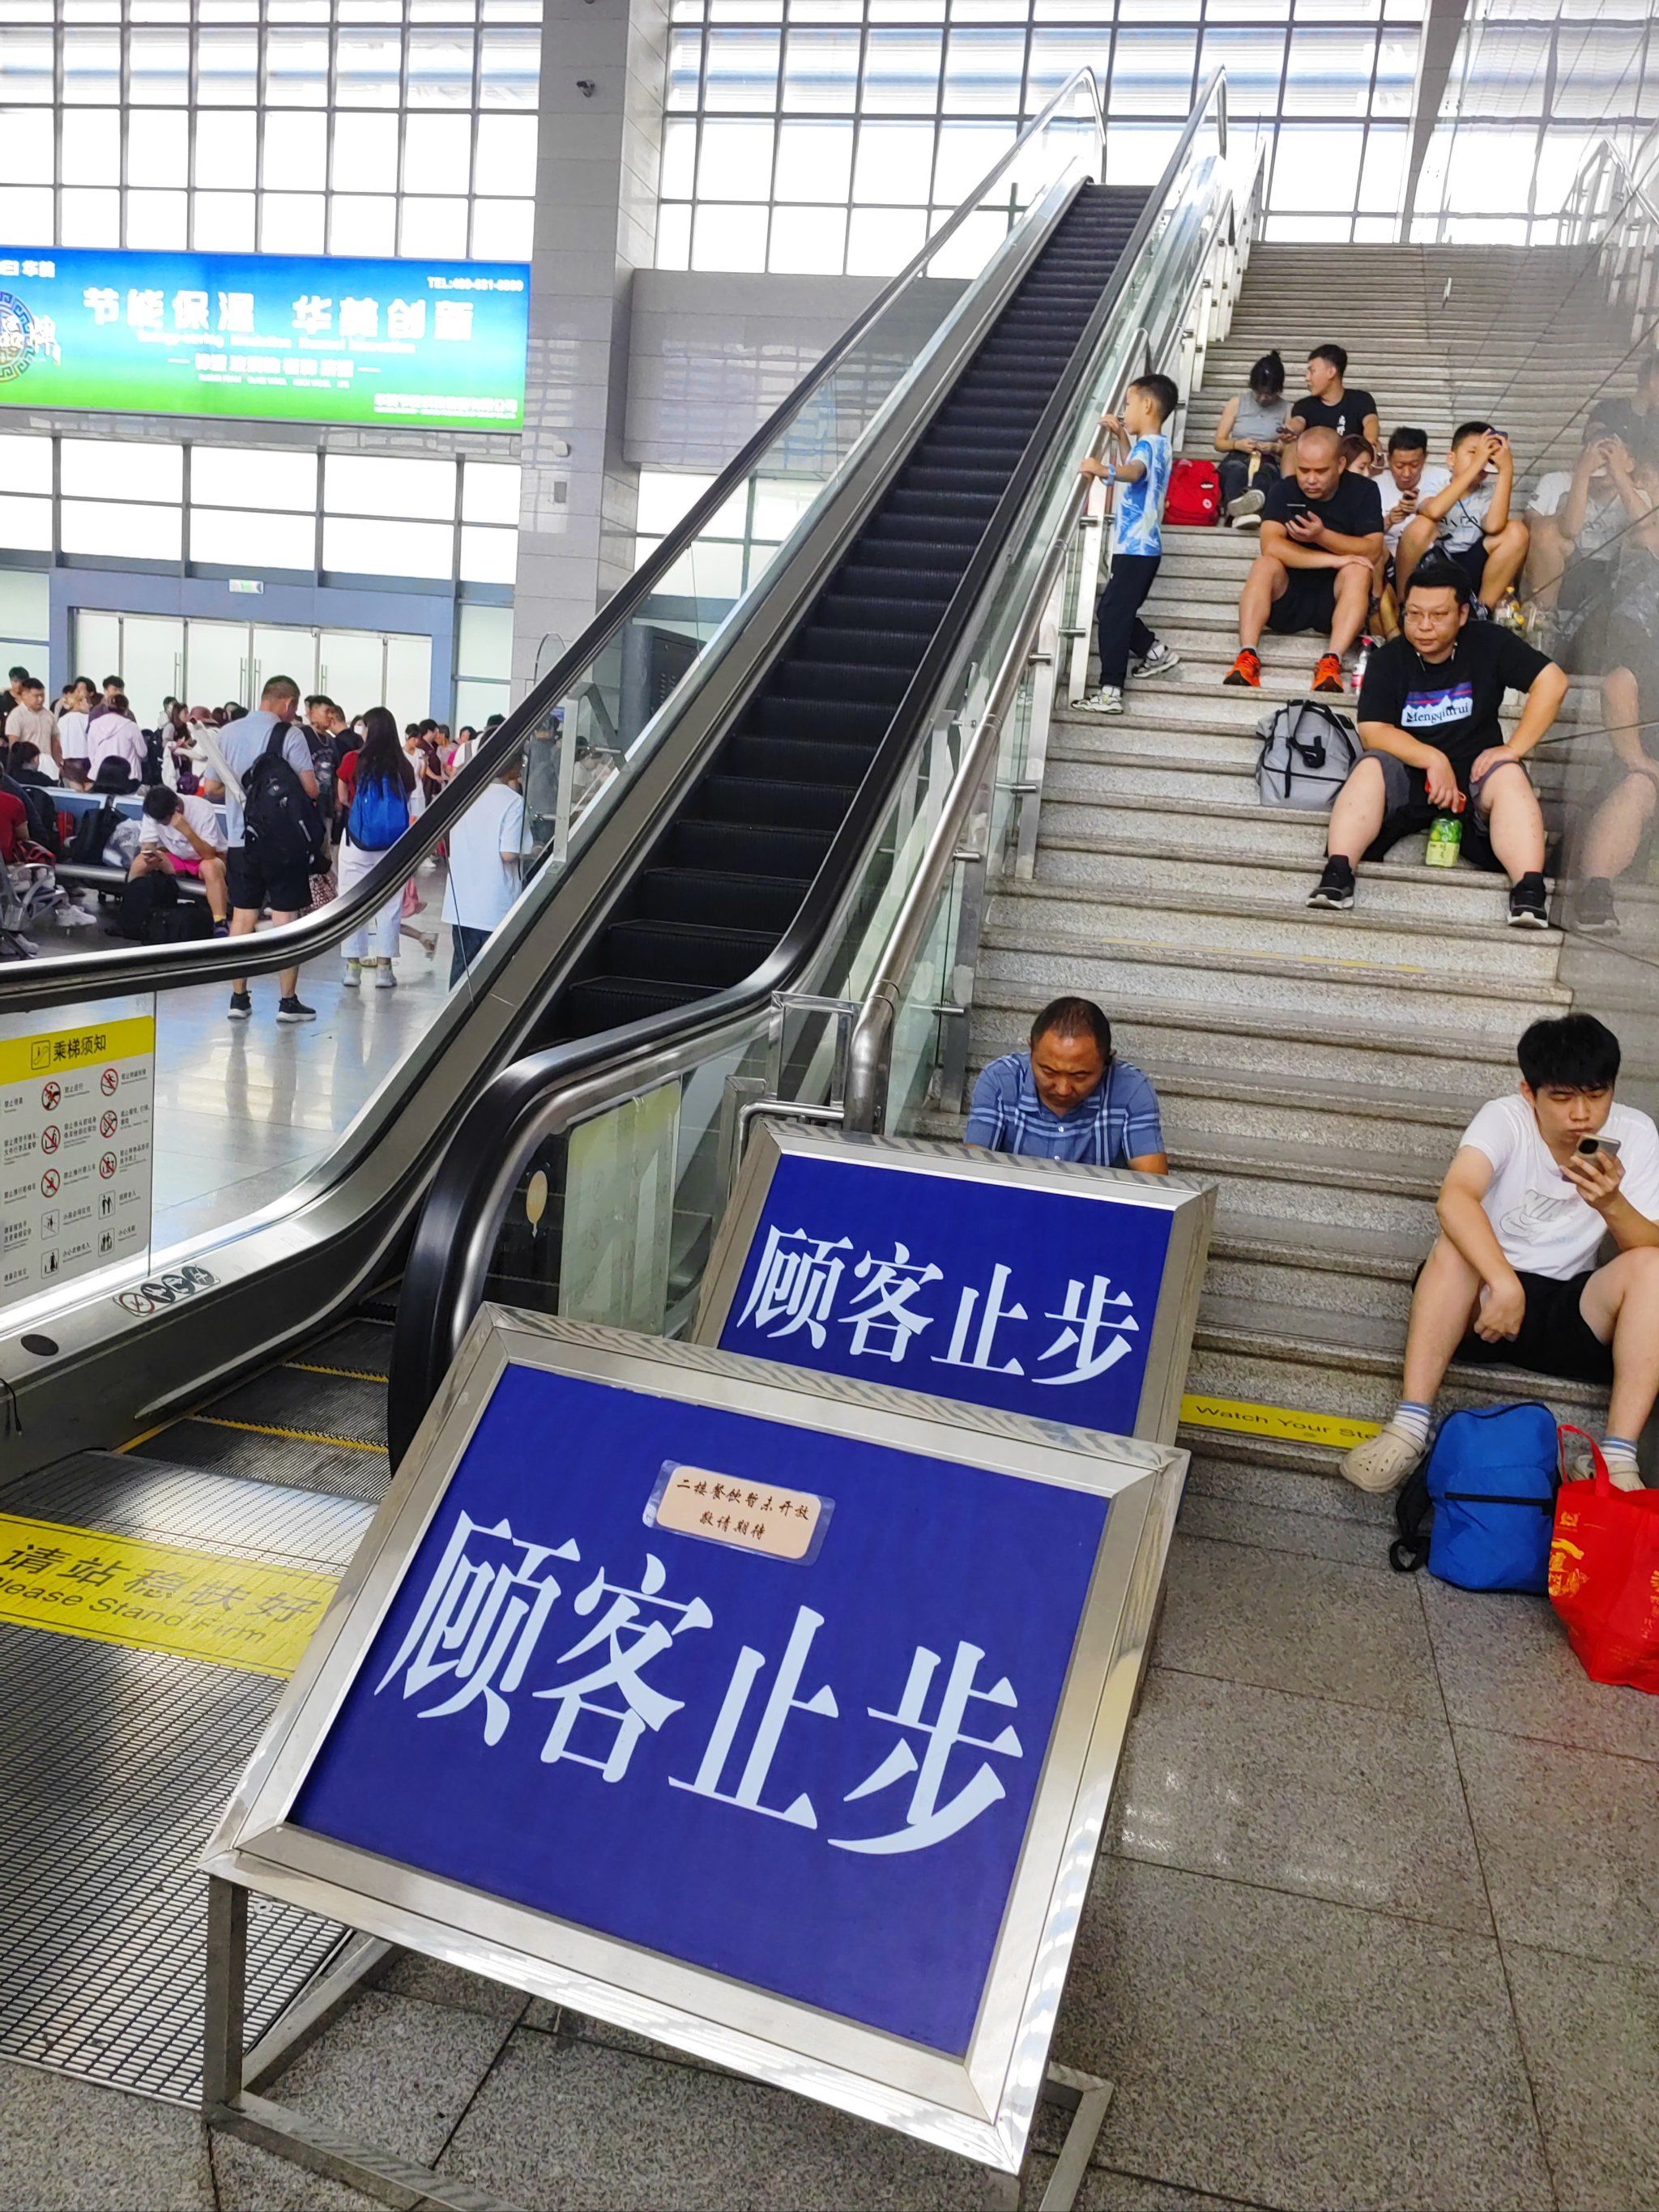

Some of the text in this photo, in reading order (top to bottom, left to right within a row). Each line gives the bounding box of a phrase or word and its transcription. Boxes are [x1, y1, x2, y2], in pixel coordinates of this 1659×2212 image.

[53, 1034, 107, 1062] 乘梯须知
[736, 1224, 1140, 1385] 顾客止步
[1196, 1405, 1378, 1439] Watch Your Ste
[676, 1479, 809, 1520] 二楼餐饮暂未开放
[699, 1511, 766, 1541] 敬请期待
[0, 1544, 322, 1623] 请站稳扶好
[88, 1596, 191, 1627] Stand
[190, 1618, 267, 1645] Firm
[373, 1509, 1024, 1856] 顾客止步
